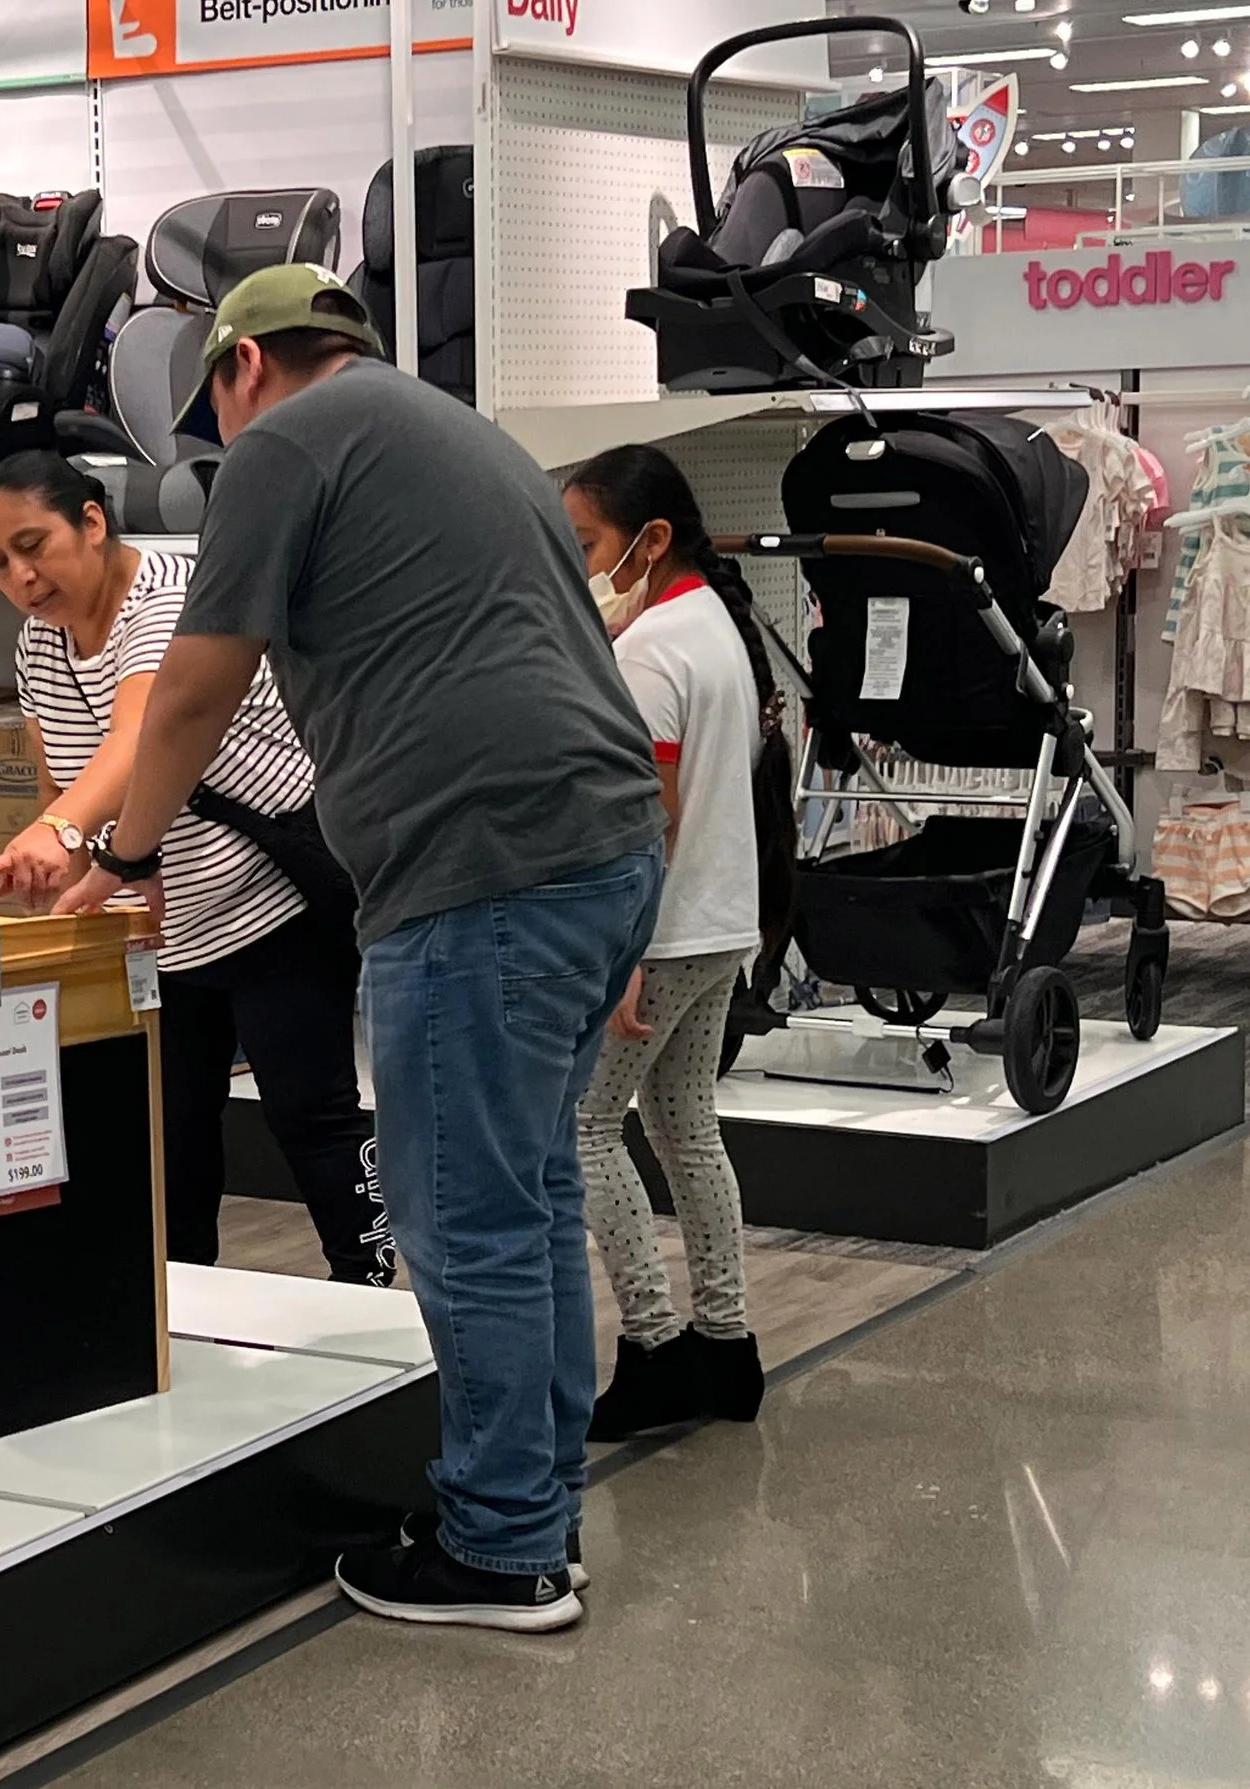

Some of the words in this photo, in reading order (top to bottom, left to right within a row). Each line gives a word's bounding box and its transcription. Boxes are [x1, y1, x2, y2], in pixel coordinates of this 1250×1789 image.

[200, 0, 390, 23] Belt-positio
[1023, 250, 1235, 310] toddler
[7, 1164, 44, 1183] $199.00
